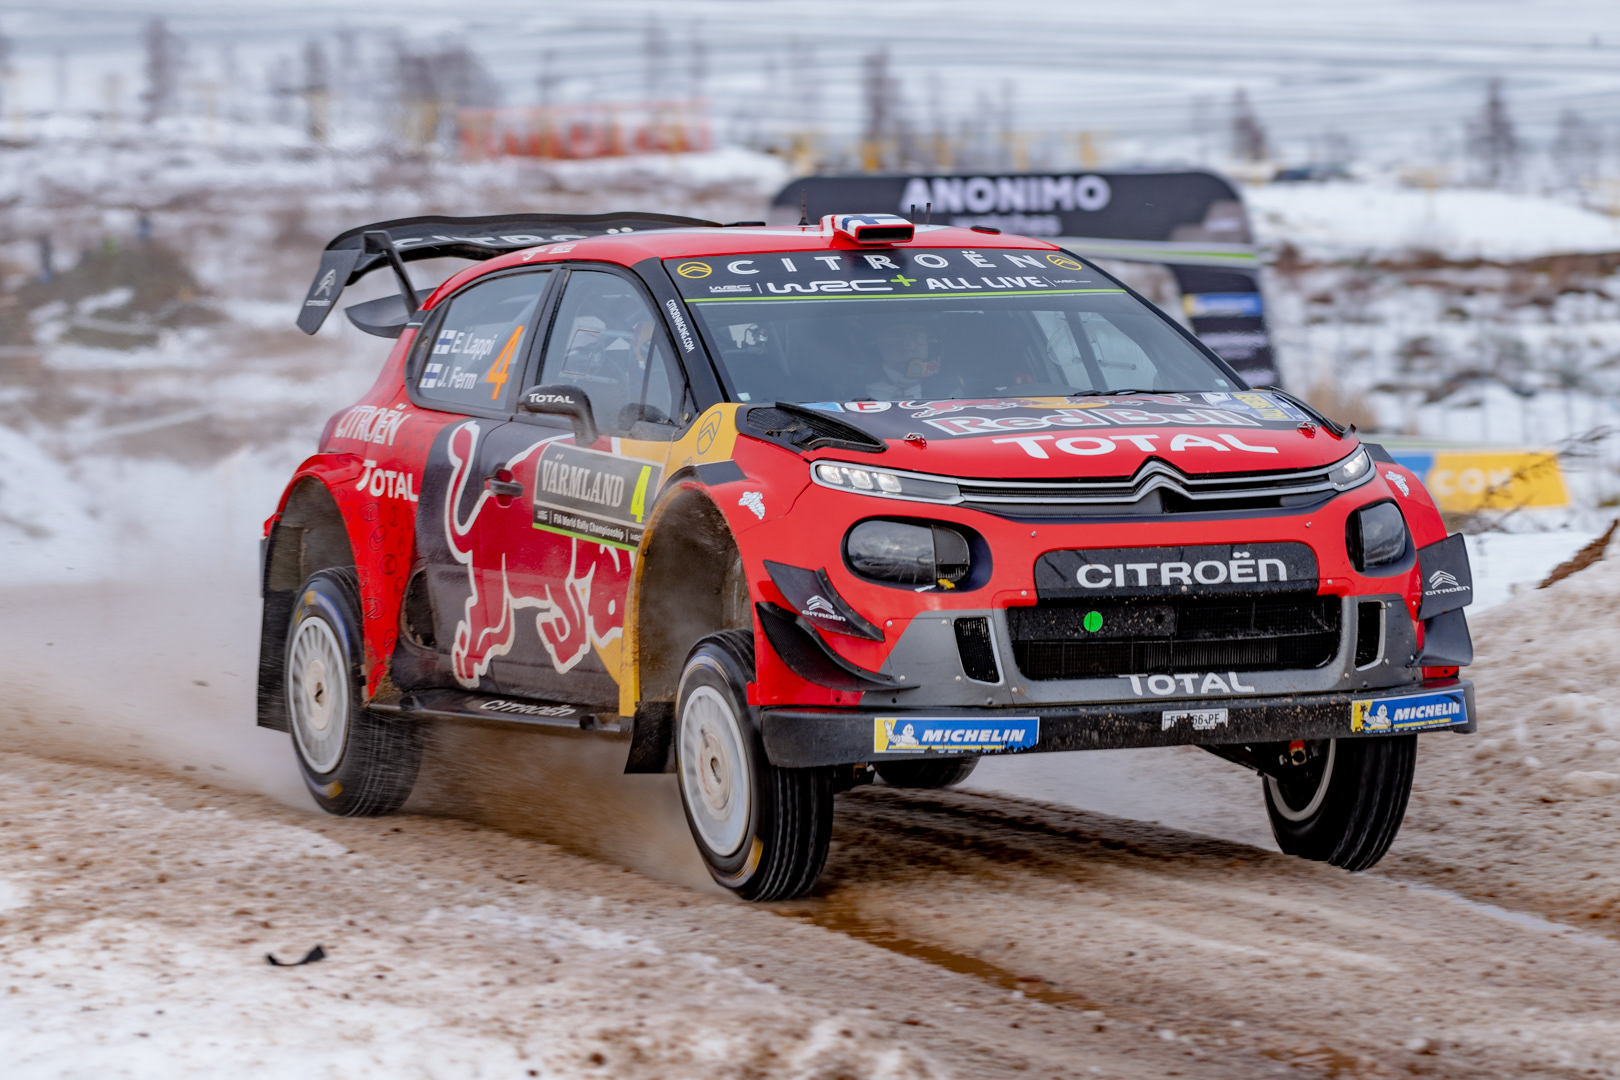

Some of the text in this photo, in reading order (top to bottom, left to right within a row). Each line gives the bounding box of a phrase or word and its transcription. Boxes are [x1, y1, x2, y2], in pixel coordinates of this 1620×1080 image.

[902, 175, 1111, 213] ANONIMO
[727, 250, 1047, 275] CITROËN
[926, 277, 982, 290] ALL
[981, 276, 1049, 289] LIVE
[450, 331, 498, 360] E. Lappi
[486, 325, 525, 400] 4
[437, 366, 478, 390] J. Ferm
[529, 393, 575, 404] TOTAL
[335, 403, 412, 447] CITROËN
[991, 433, 1279, 459] TOTAL
[355, 459, 419, 502] TOTAL
[541, 453, 625, 508] VÄRMLAND
[630, 465, 652, 524] 4
[562, 515, 577, 528] World
[577, 518, 589, 533] Rally
[589, 521, 624, 541] Championship
[1076, 551, 1288, 589] CITROËN
[1425, 585, 1471, 596] CITROËN
[802, 609, 846, 622] CITROËN
[1118, 671, 1256, 696] TOTAL
[480, 700, 577, 717] CITROËN
[1393, 702, 1460, 722] MICHELIN
[921, 728, 1026, 743] MICHELIN
